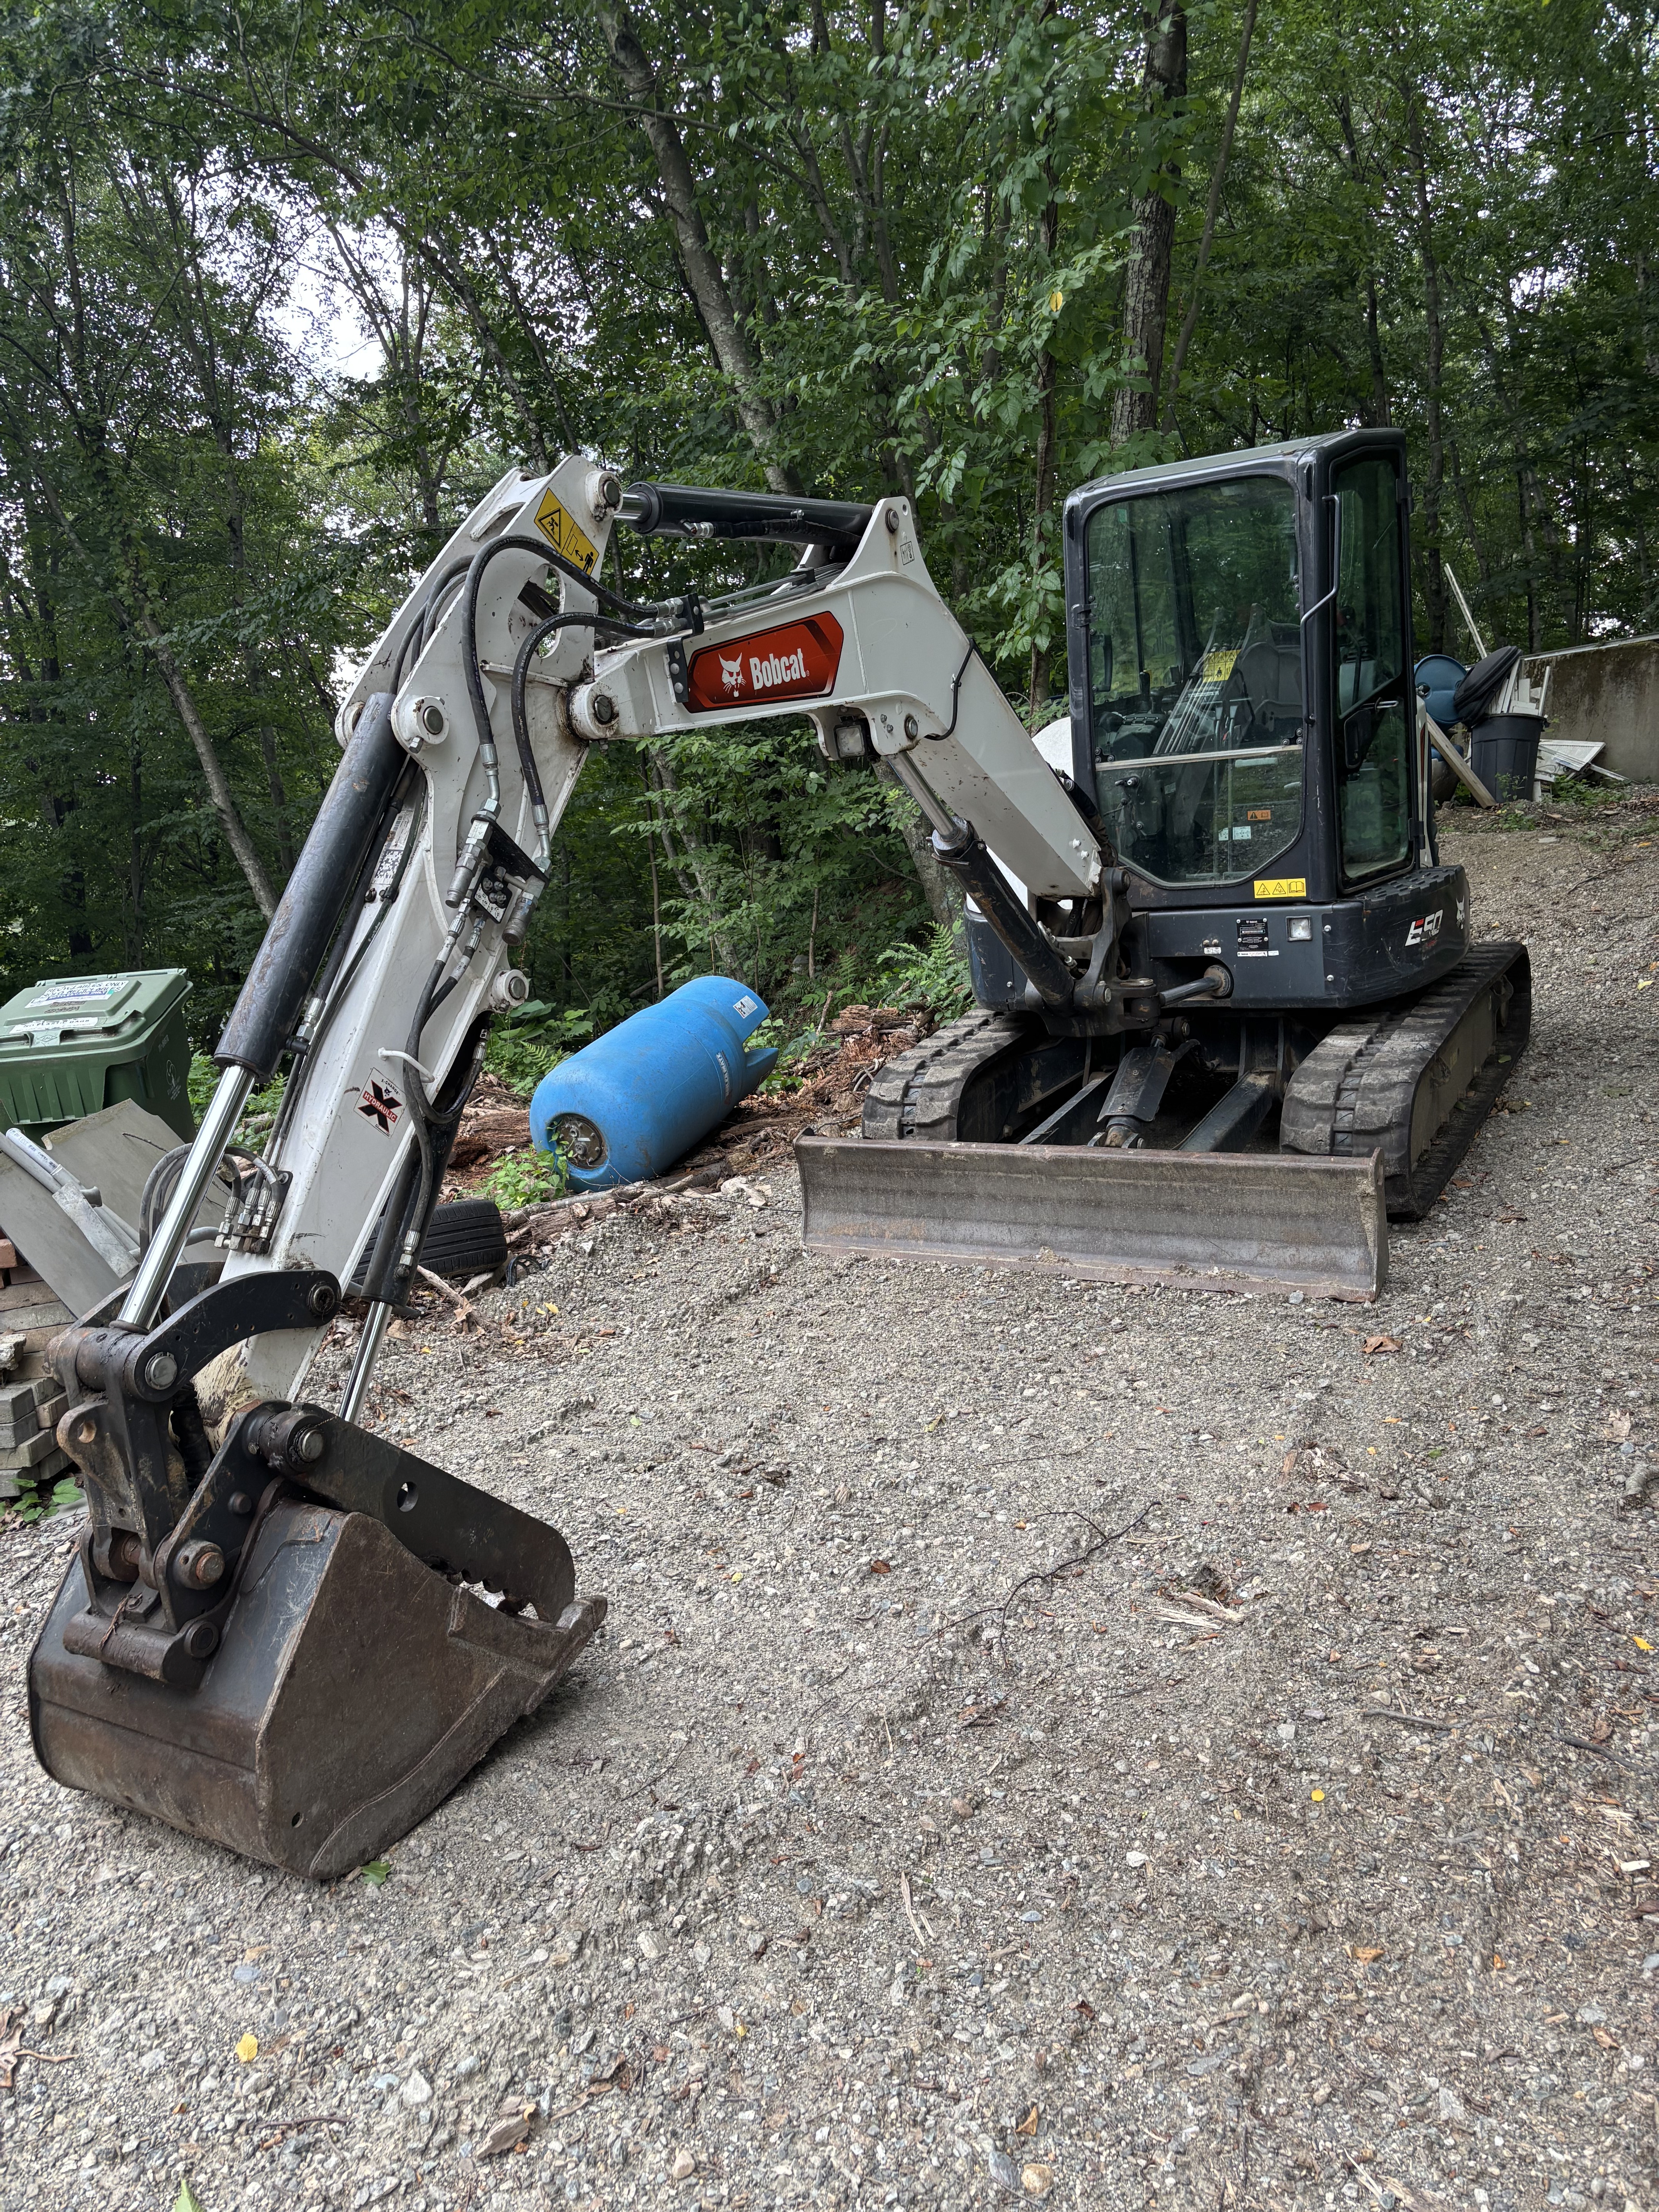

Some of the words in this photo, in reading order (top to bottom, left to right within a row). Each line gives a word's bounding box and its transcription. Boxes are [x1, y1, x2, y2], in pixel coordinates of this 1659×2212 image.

[749, 648, 806, 690] Bobcat
[47, 983, 102, 992] RECYCLABLES
[364, 1092, 396, 1121] HYDRAULIC
